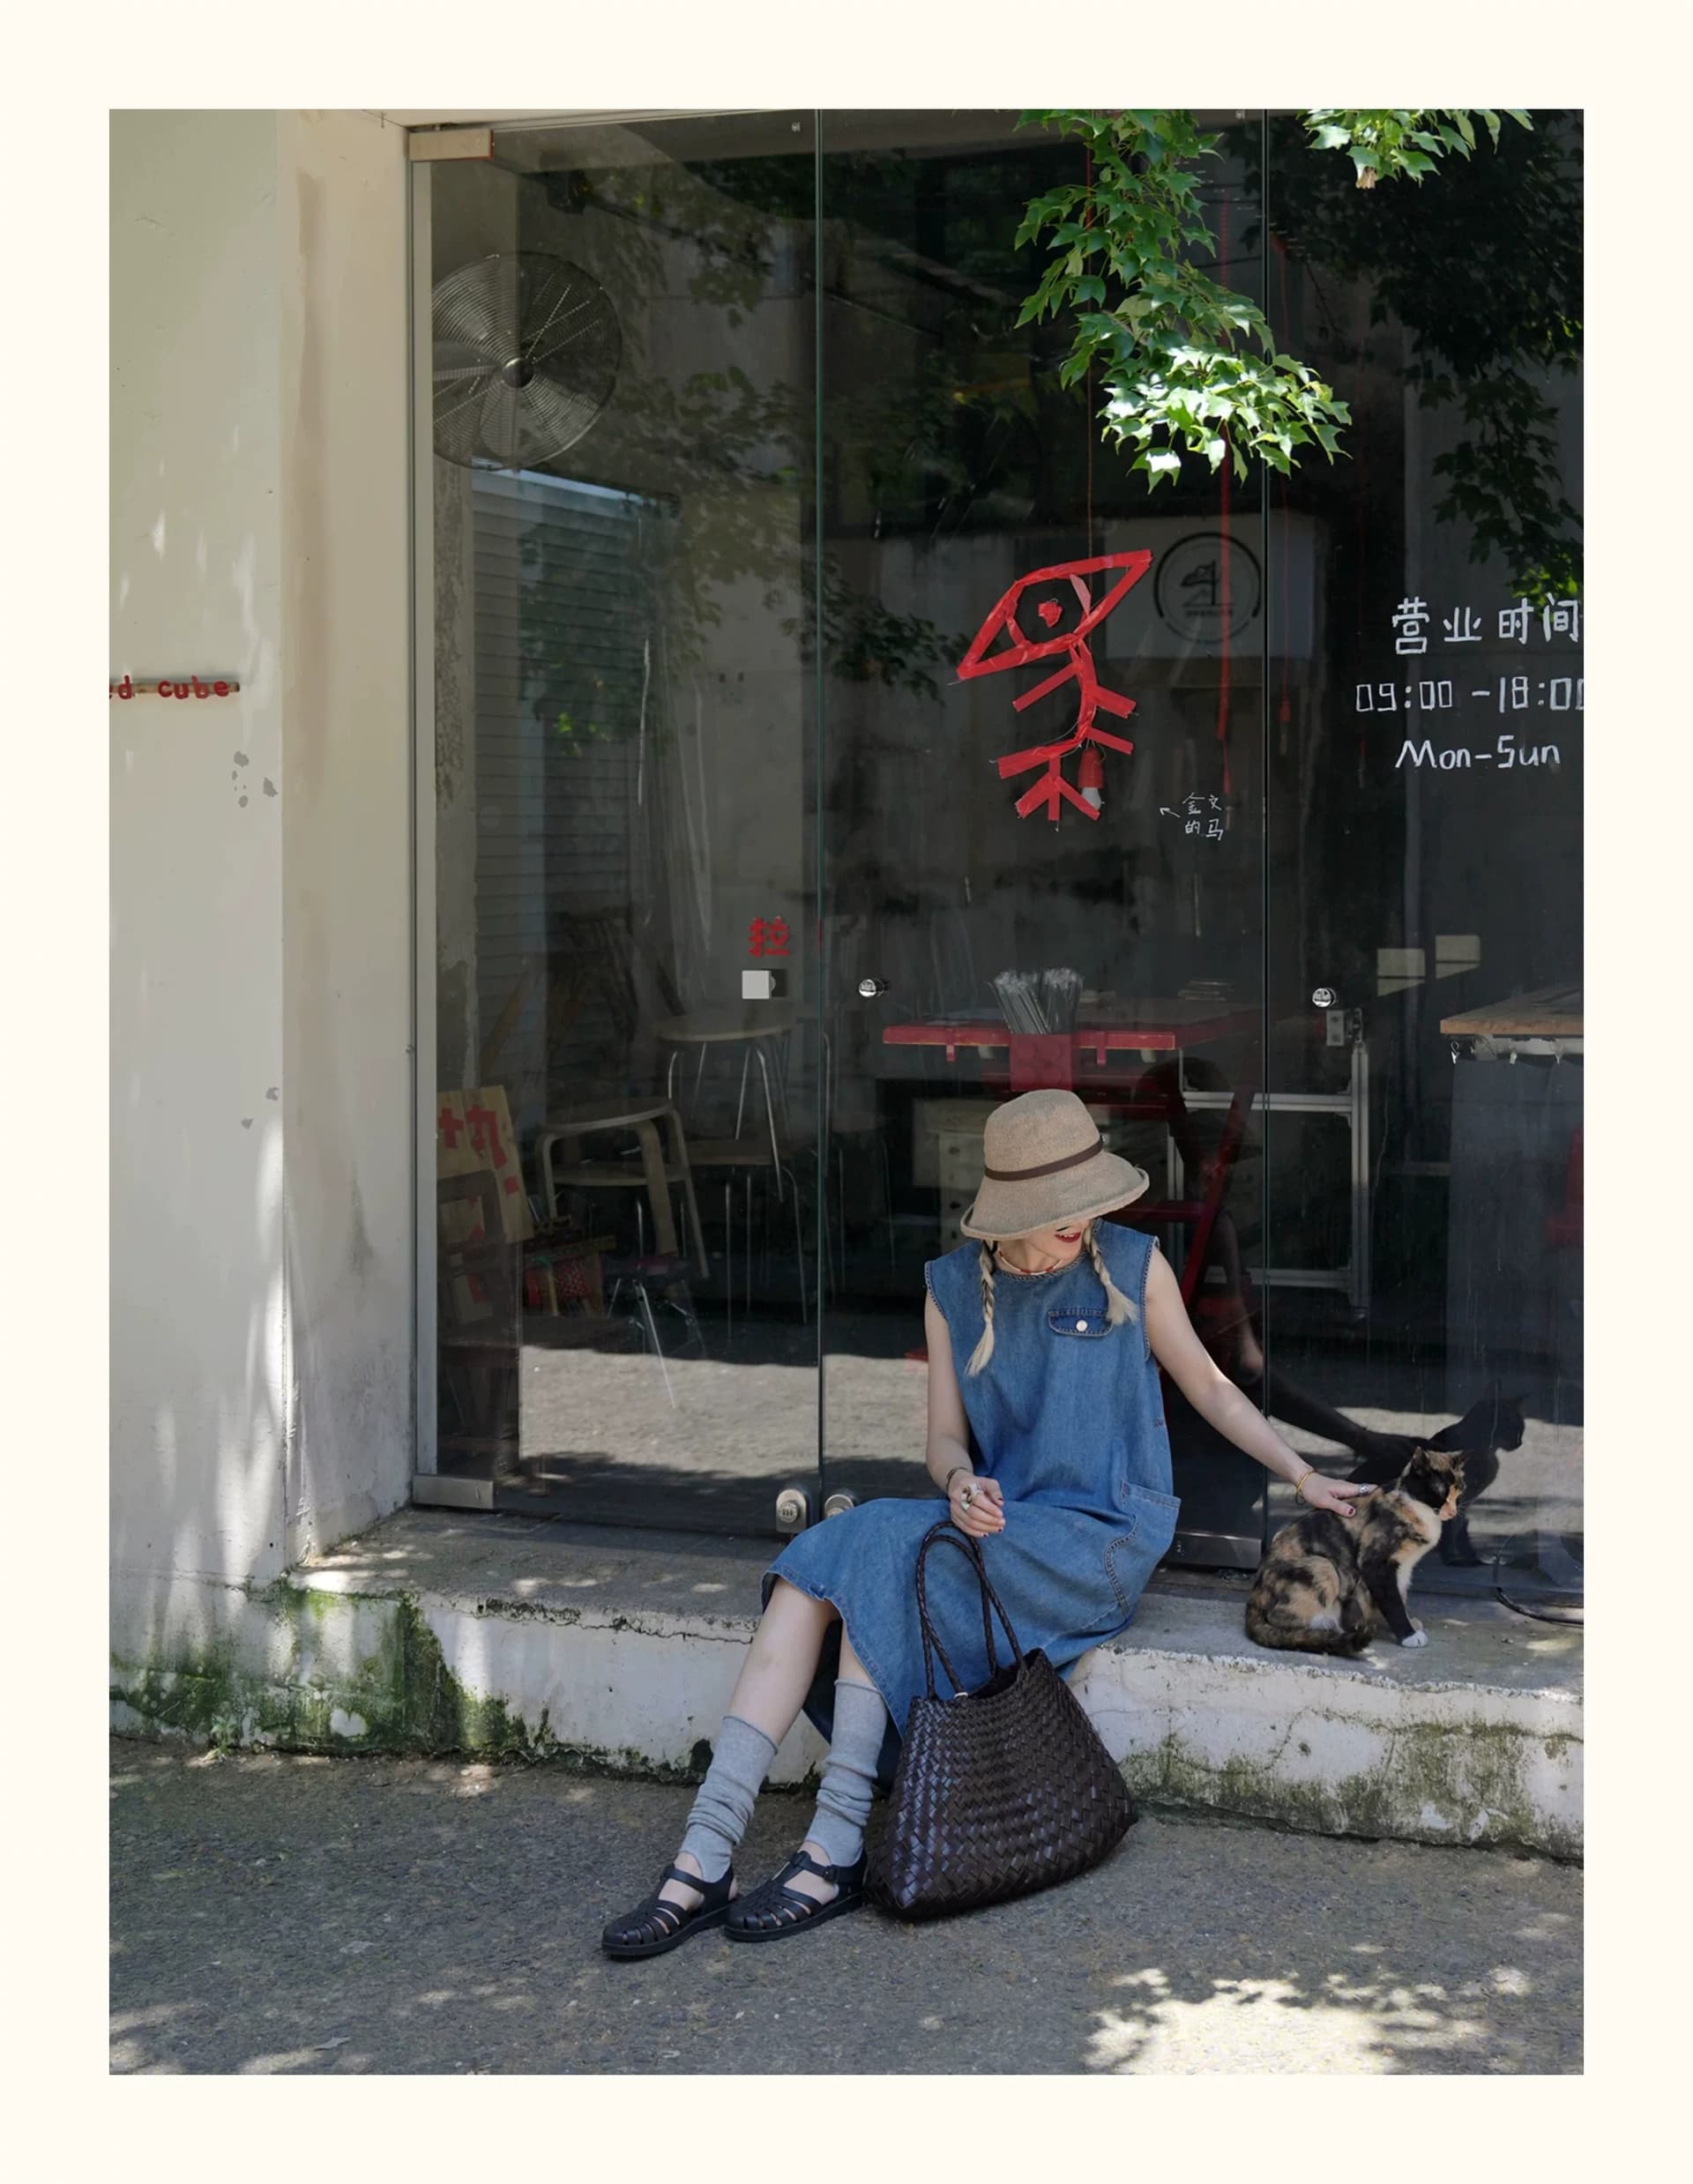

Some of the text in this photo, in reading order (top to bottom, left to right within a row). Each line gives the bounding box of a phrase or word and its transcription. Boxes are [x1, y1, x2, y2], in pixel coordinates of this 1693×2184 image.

[1391, 592, 1580, 654] 营业时间
[109, 675, 230, 699] d cube
[1355, 680, 1453, 712] 09:00
[1395, 734, 1561, 770] Mon-Sun
[1182, 792, 1223, 816] 金文
[1184, 817, 1224, 841] 的马
[748, 916, 791, 958] 拉
